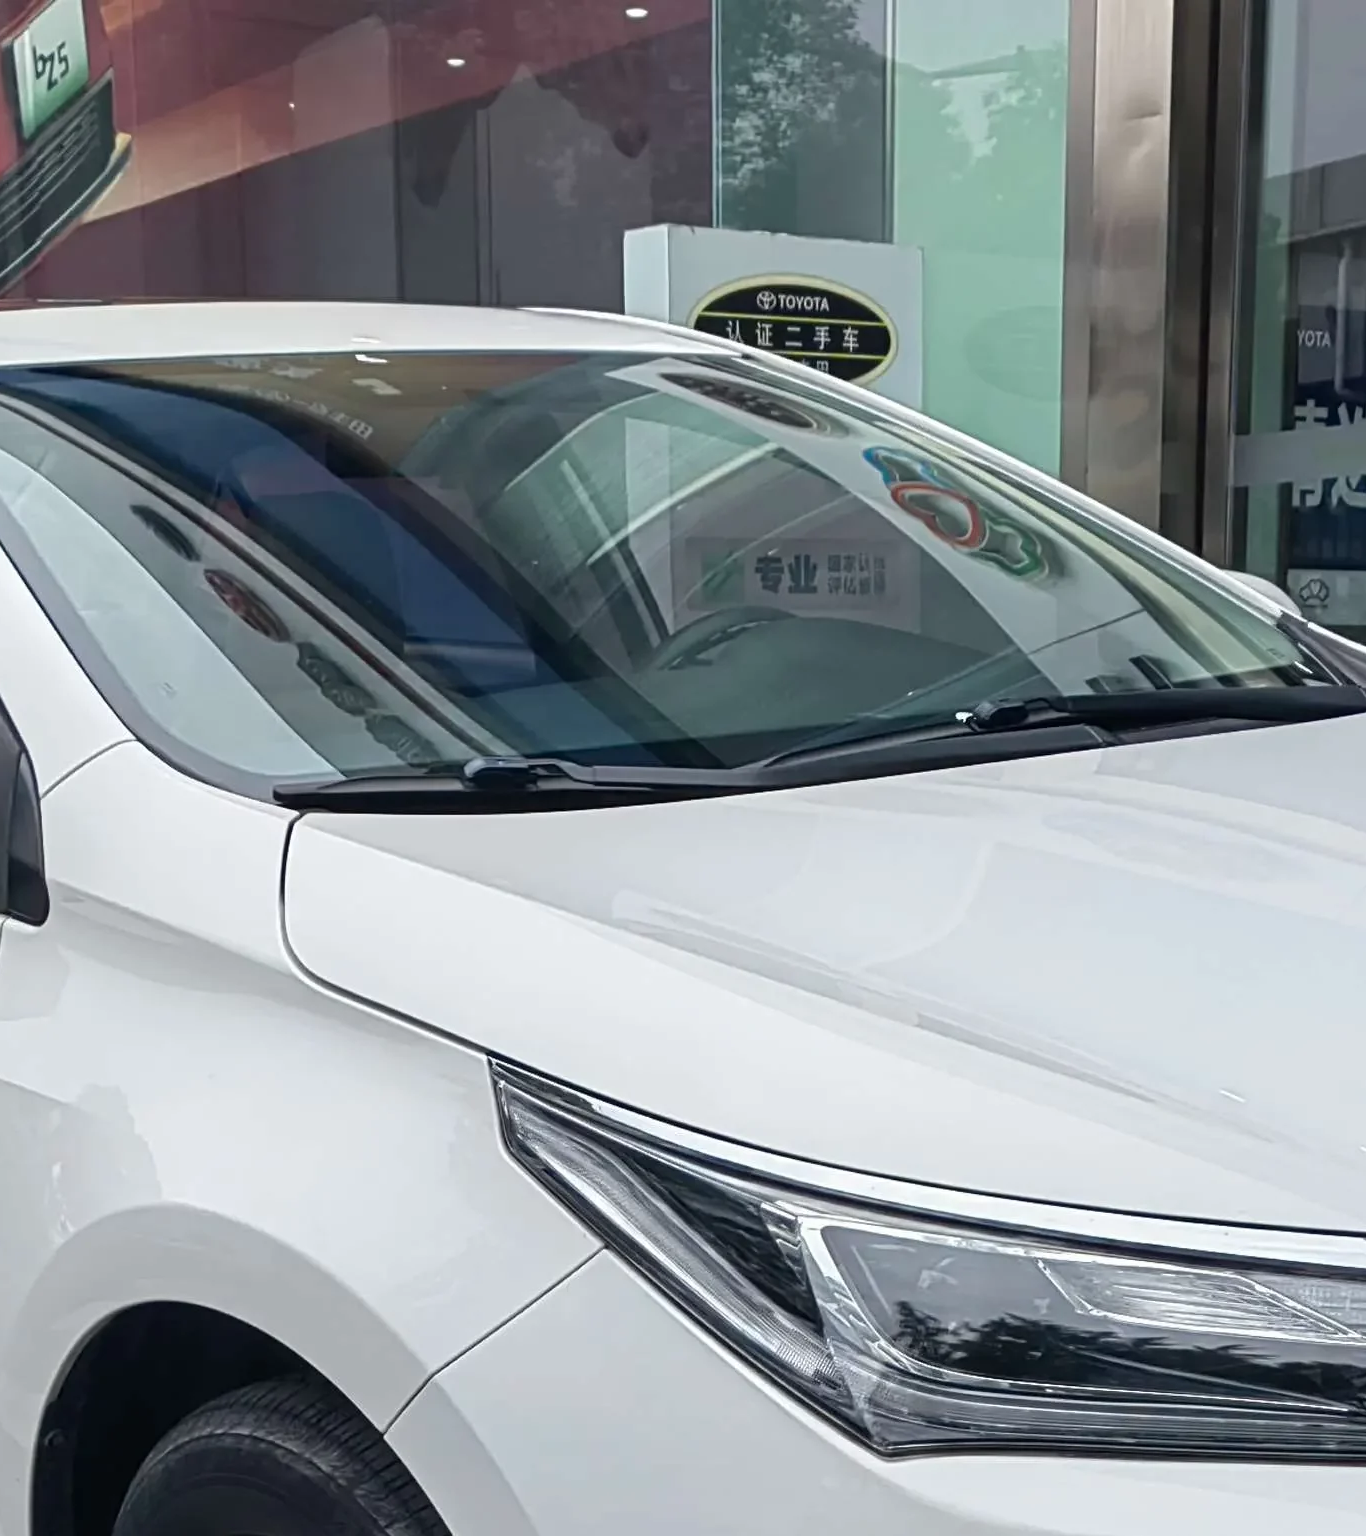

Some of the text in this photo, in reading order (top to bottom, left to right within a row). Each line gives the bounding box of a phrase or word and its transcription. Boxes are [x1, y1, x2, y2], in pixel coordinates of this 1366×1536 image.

[777, 294, 830, 312] TOYOTA
[725, 319, 859, 353] 认证二手车
[755, 554, 818, 594] 专业
